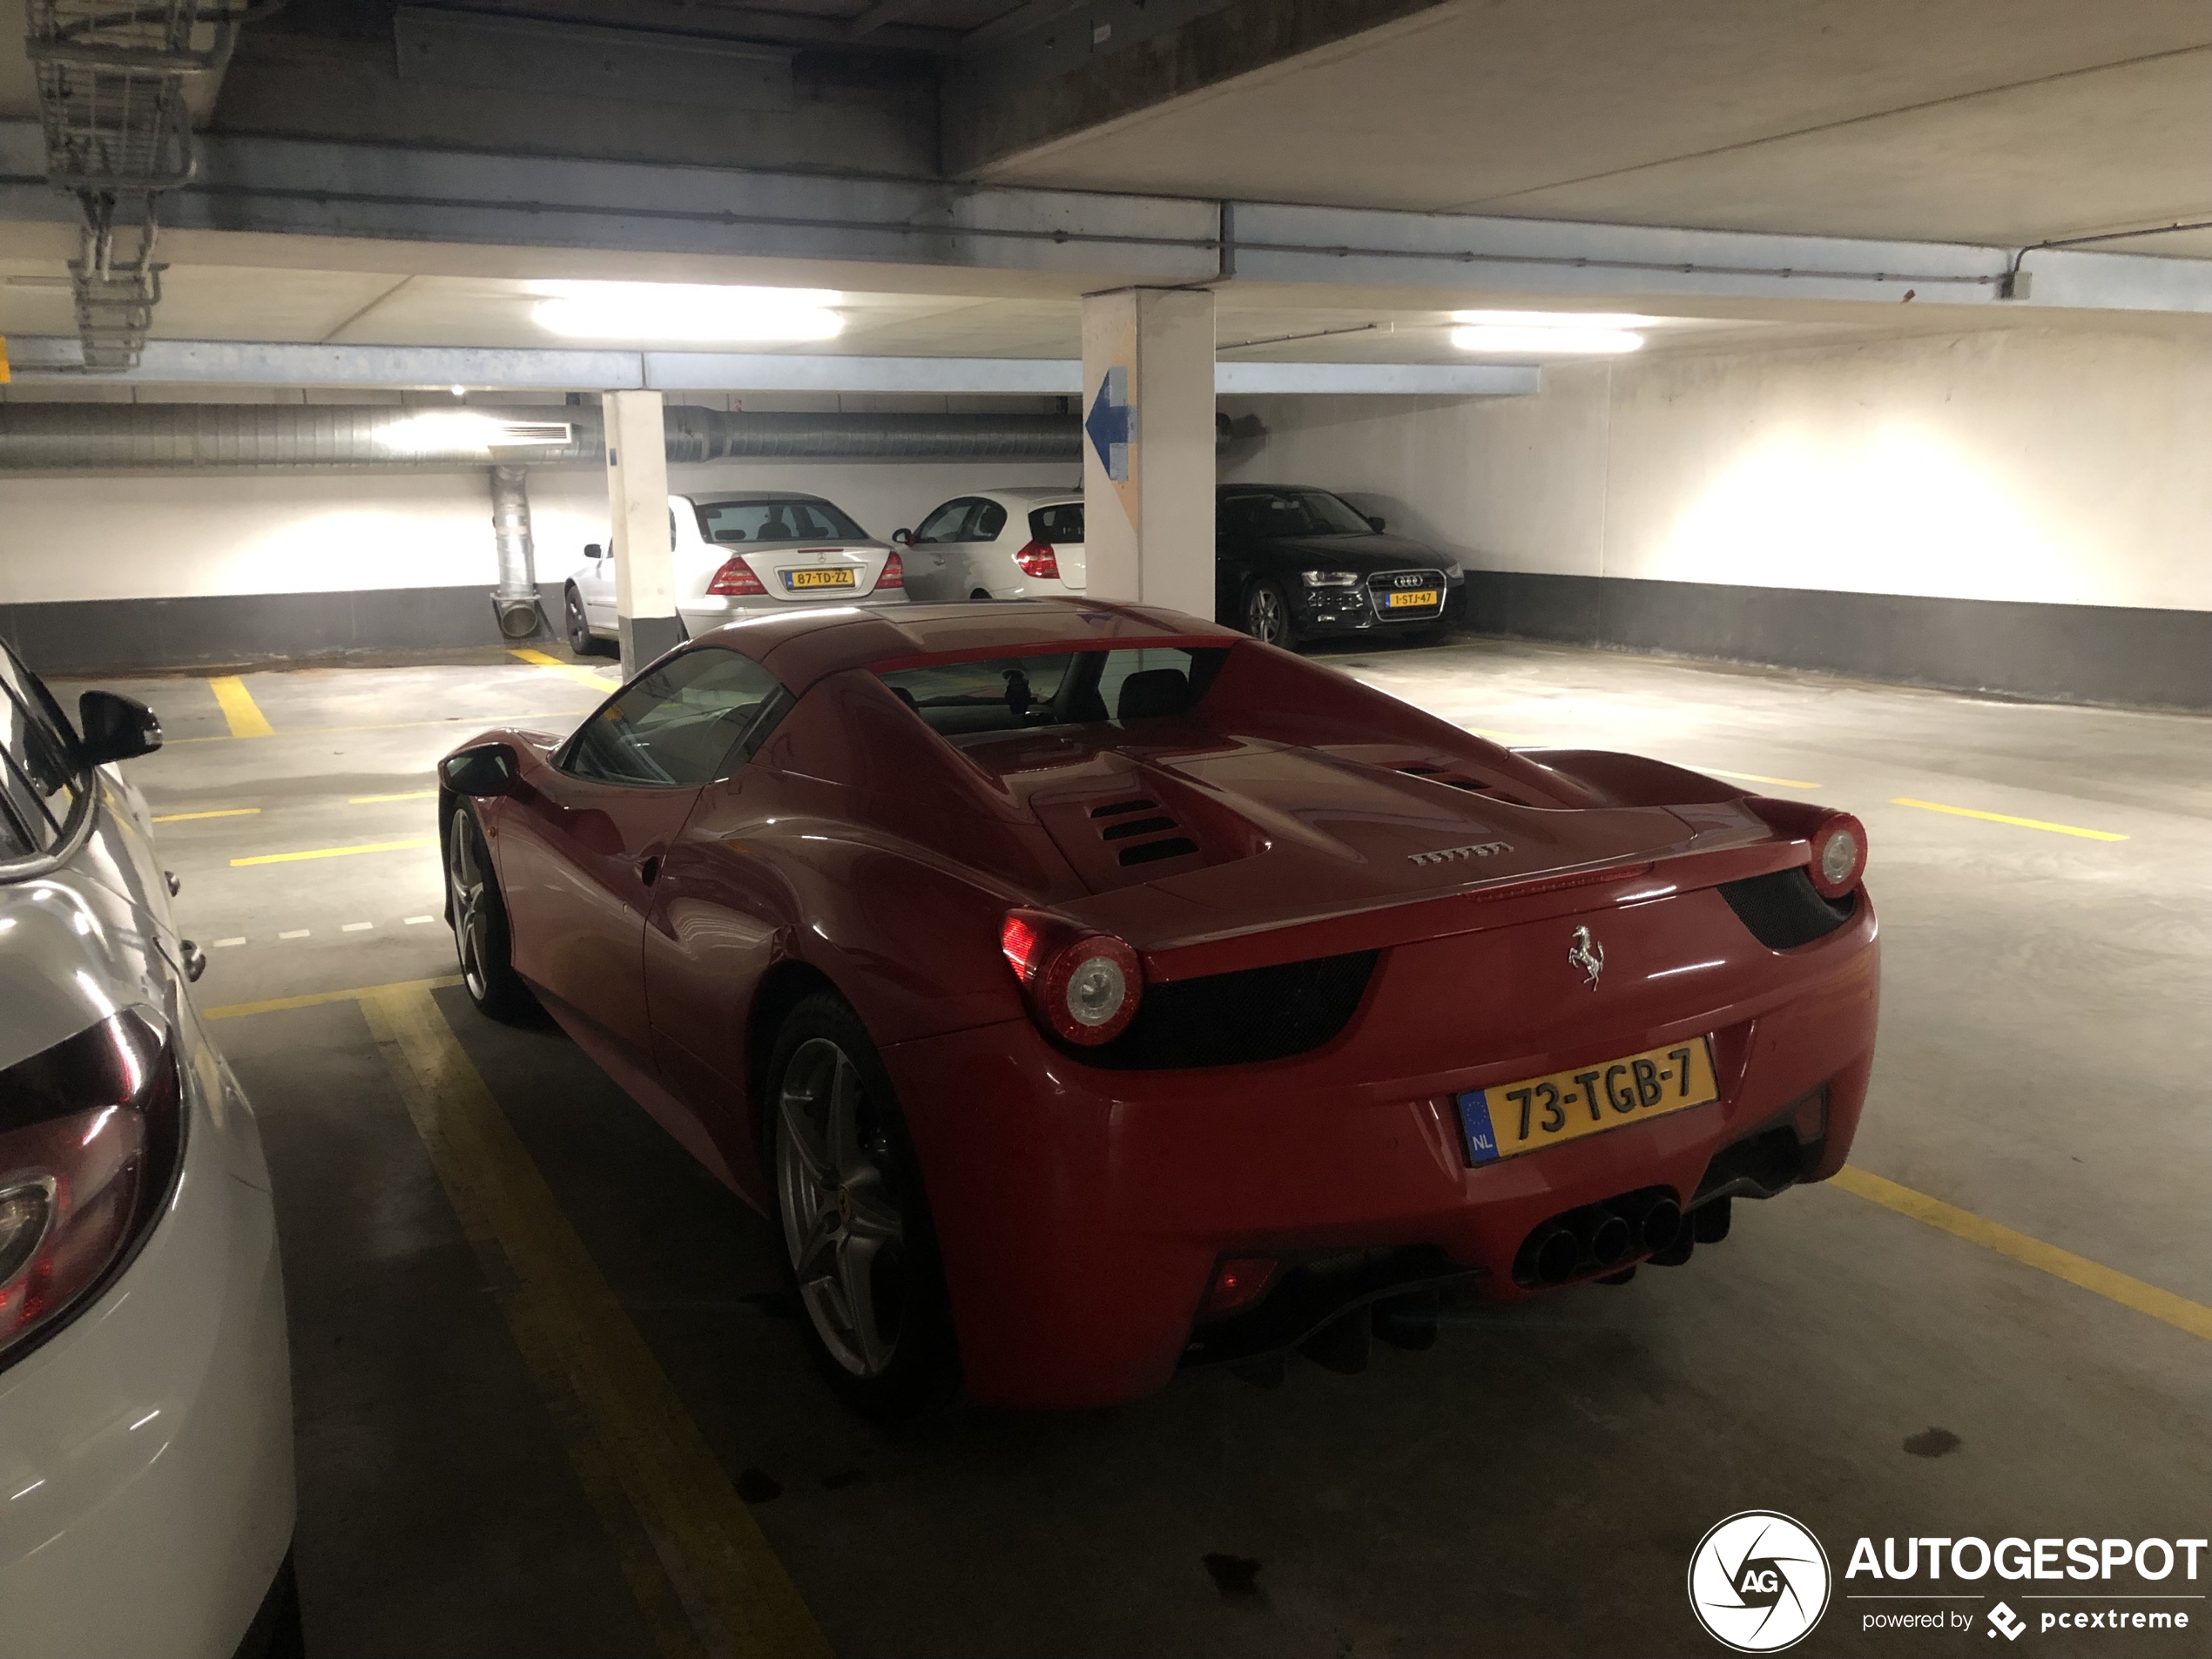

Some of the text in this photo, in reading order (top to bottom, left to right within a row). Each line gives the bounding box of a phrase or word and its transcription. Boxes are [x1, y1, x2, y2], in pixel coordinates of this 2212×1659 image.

[798, 572, 848, 584] 87-TD-ZZ
[1395, 593, 1431, 604] 1-STJ-47
[1506, 1048, 1690, 1140] 73-TGB-7
[1472, 1134, 1493, 1150] NL
